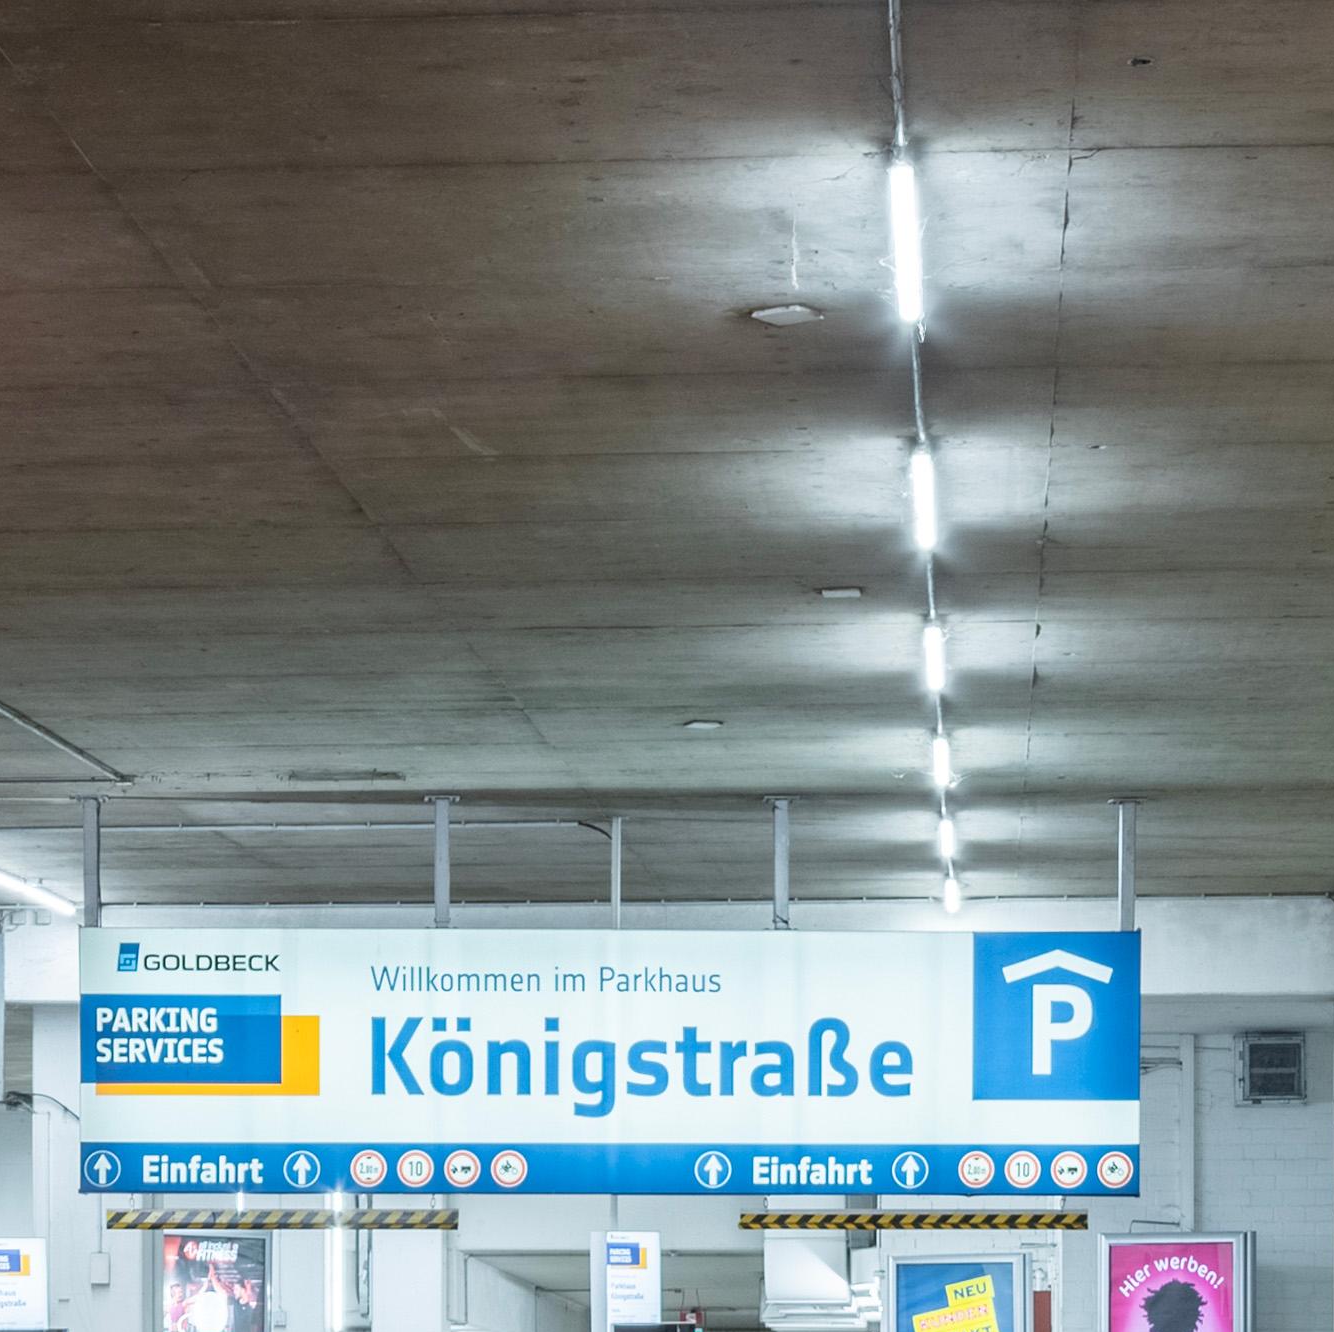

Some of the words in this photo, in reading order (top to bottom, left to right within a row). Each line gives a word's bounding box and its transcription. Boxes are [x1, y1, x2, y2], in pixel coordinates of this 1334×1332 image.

[144, 954, 281, 972] GOLDBECK
[371, 966, 541, 992] Willkommen
[555, 966, 586, 992] im
[600, 966, 722, 993] Parkhaus
[96, 1007, 218, 1033] PARKING
[1032, 984, 1094, 1076] P
[96, 1038, 224, 1064] SERVICES
[371, 1016, 914, 1118] Königstraße
[142, 1154, 264, 1184] Einfahrt
[408, 1161, 424, 1177] 10
[752, 1152, 873, 1186] Einfahrt
[1016, 1162, 1030, 1178] 10
[1119, 1264, 1151, 1297] Hier
[1153, 1255, 1224, 1289] werben!
[953, 1282, 987, 1300] NEU
[919, 1303, 989, 1332] KUNDEN
